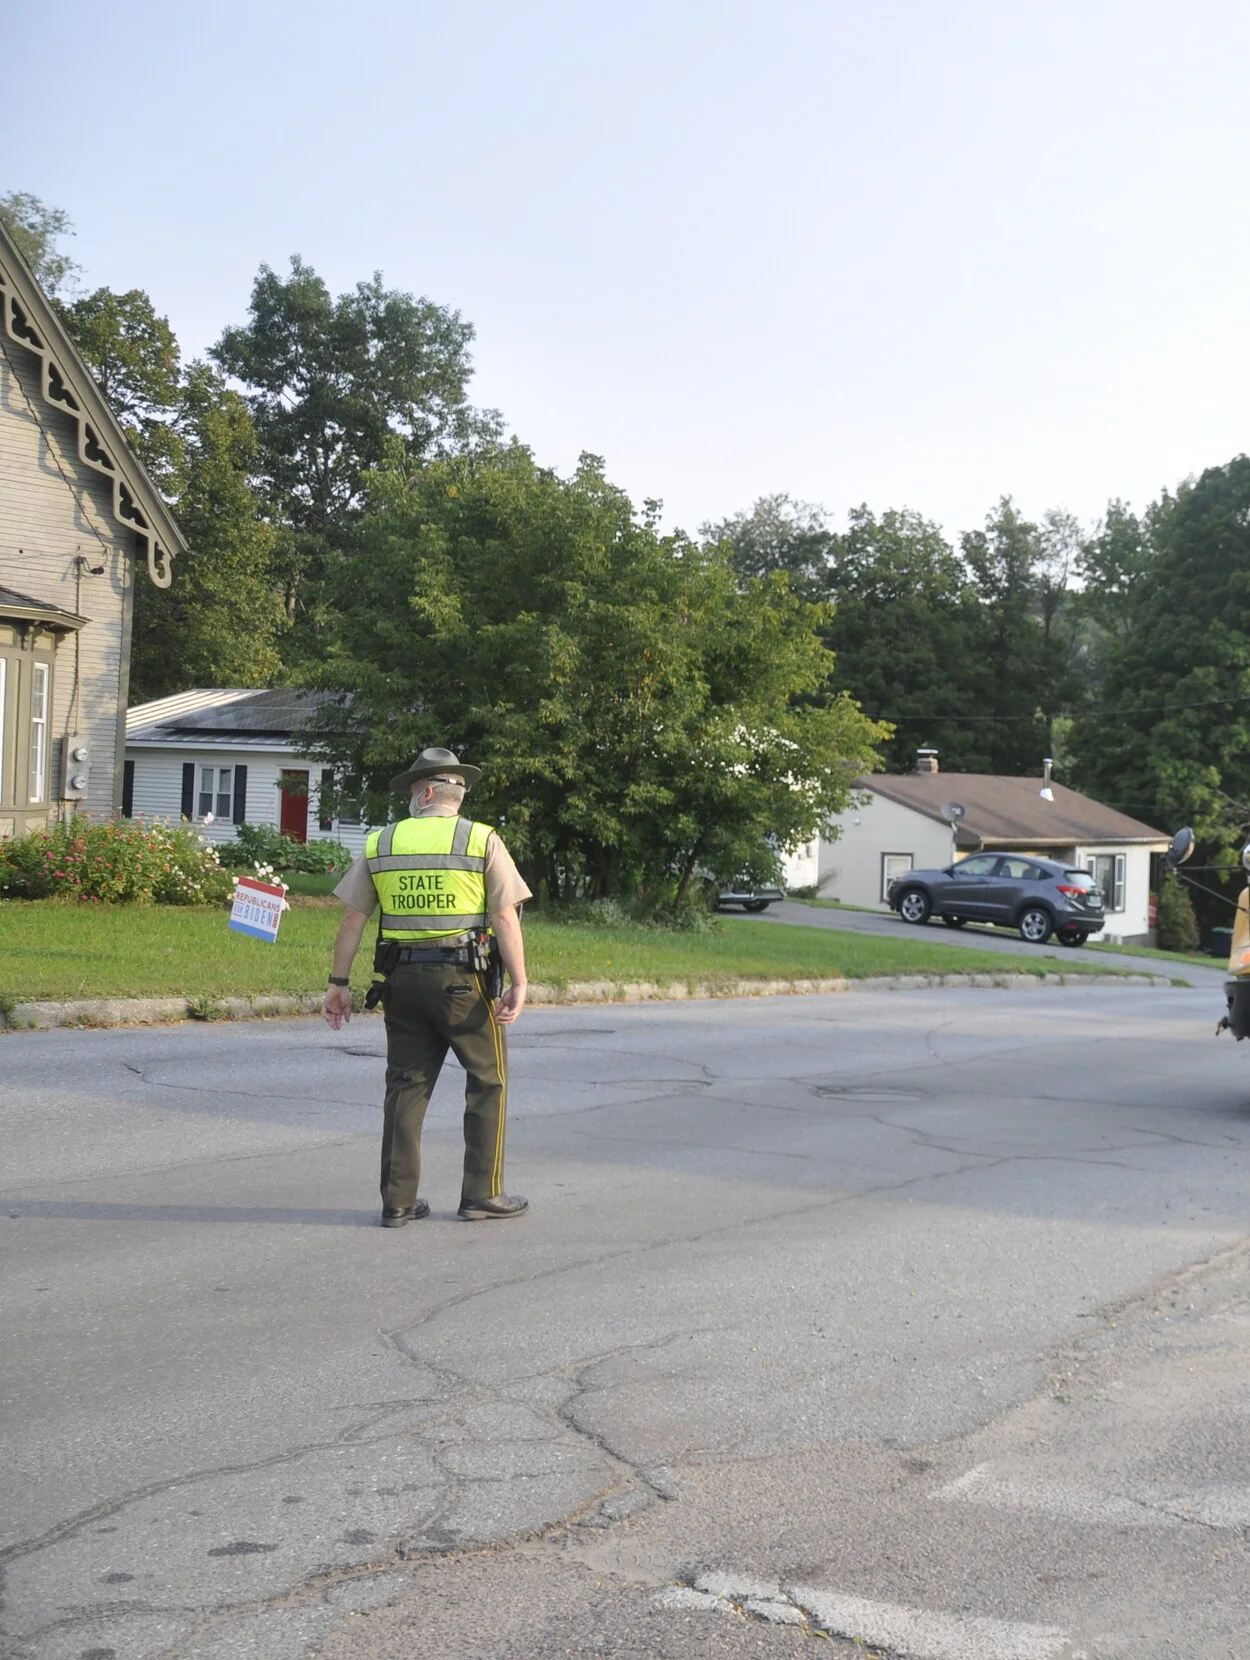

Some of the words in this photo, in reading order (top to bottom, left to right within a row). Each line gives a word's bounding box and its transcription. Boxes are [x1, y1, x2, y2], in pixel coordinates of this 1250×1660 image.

[399, 875, 444, 890] STATE
[236, 891, 281, 912] REPUBLICANS
[391, 893, 456, 909] TROOPER
[243, 904, 273, 927] BIDEN
